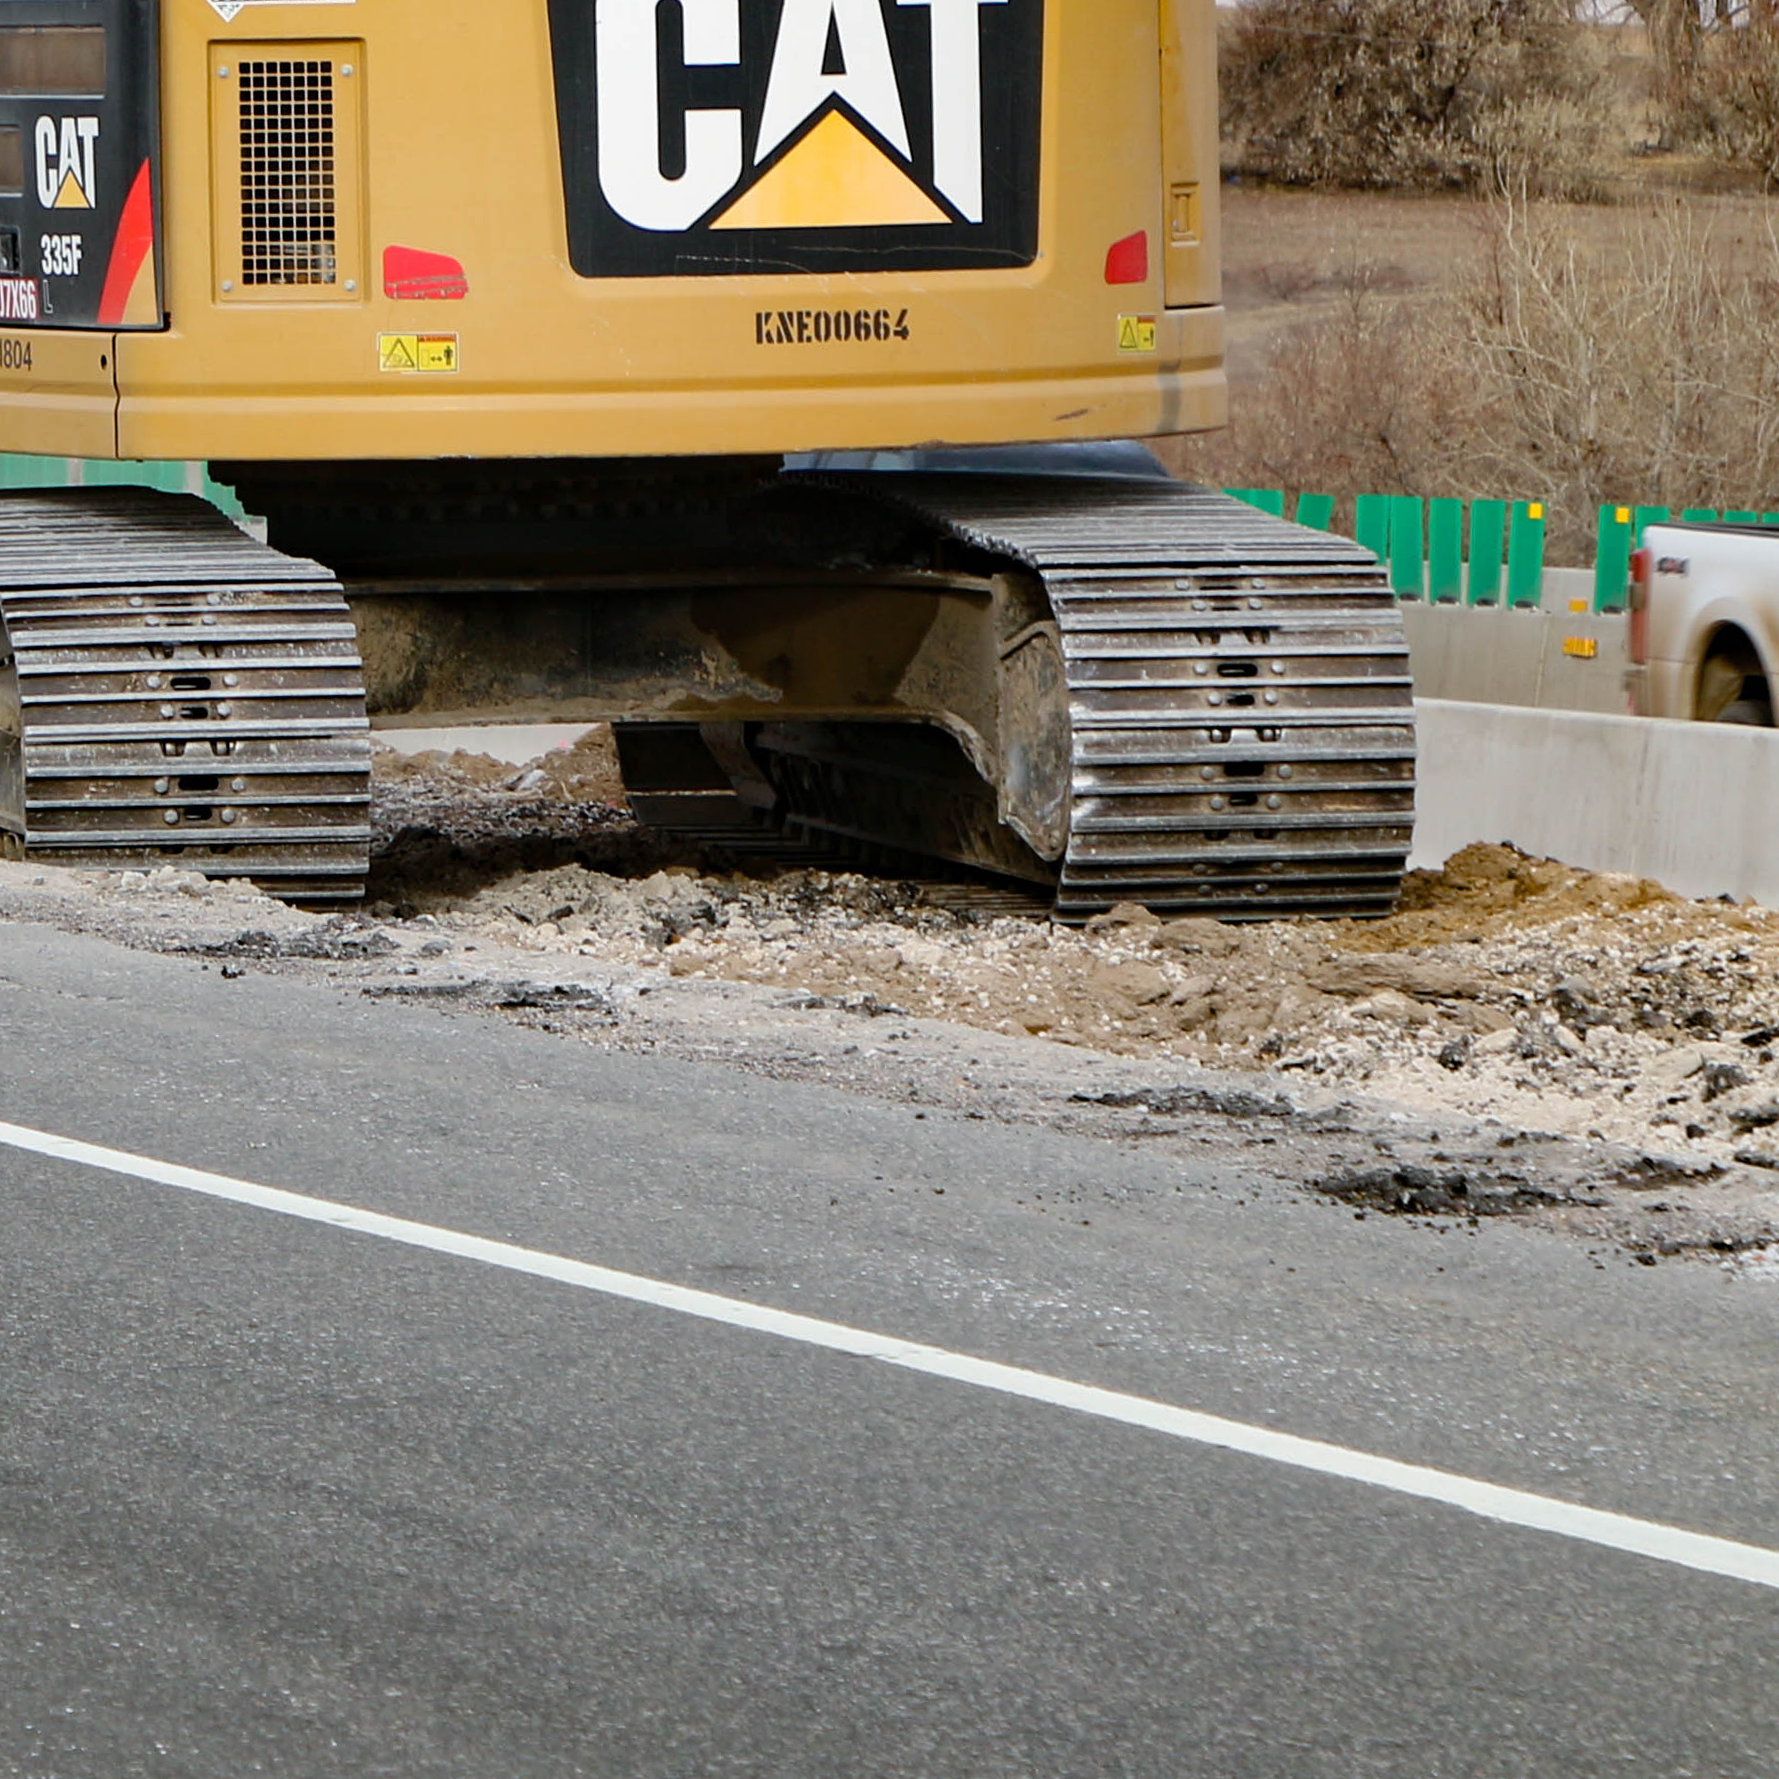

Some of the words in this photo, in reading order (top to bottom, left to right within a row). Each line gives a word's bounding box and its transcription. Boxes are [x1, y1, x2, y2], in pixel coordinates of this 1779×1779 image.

[35, 115, 100, 209] CAT
[41, 234, 82, 276] 335F
[43, 279, 53, 314] L
[756, 308, 910, 344] KNE00664
